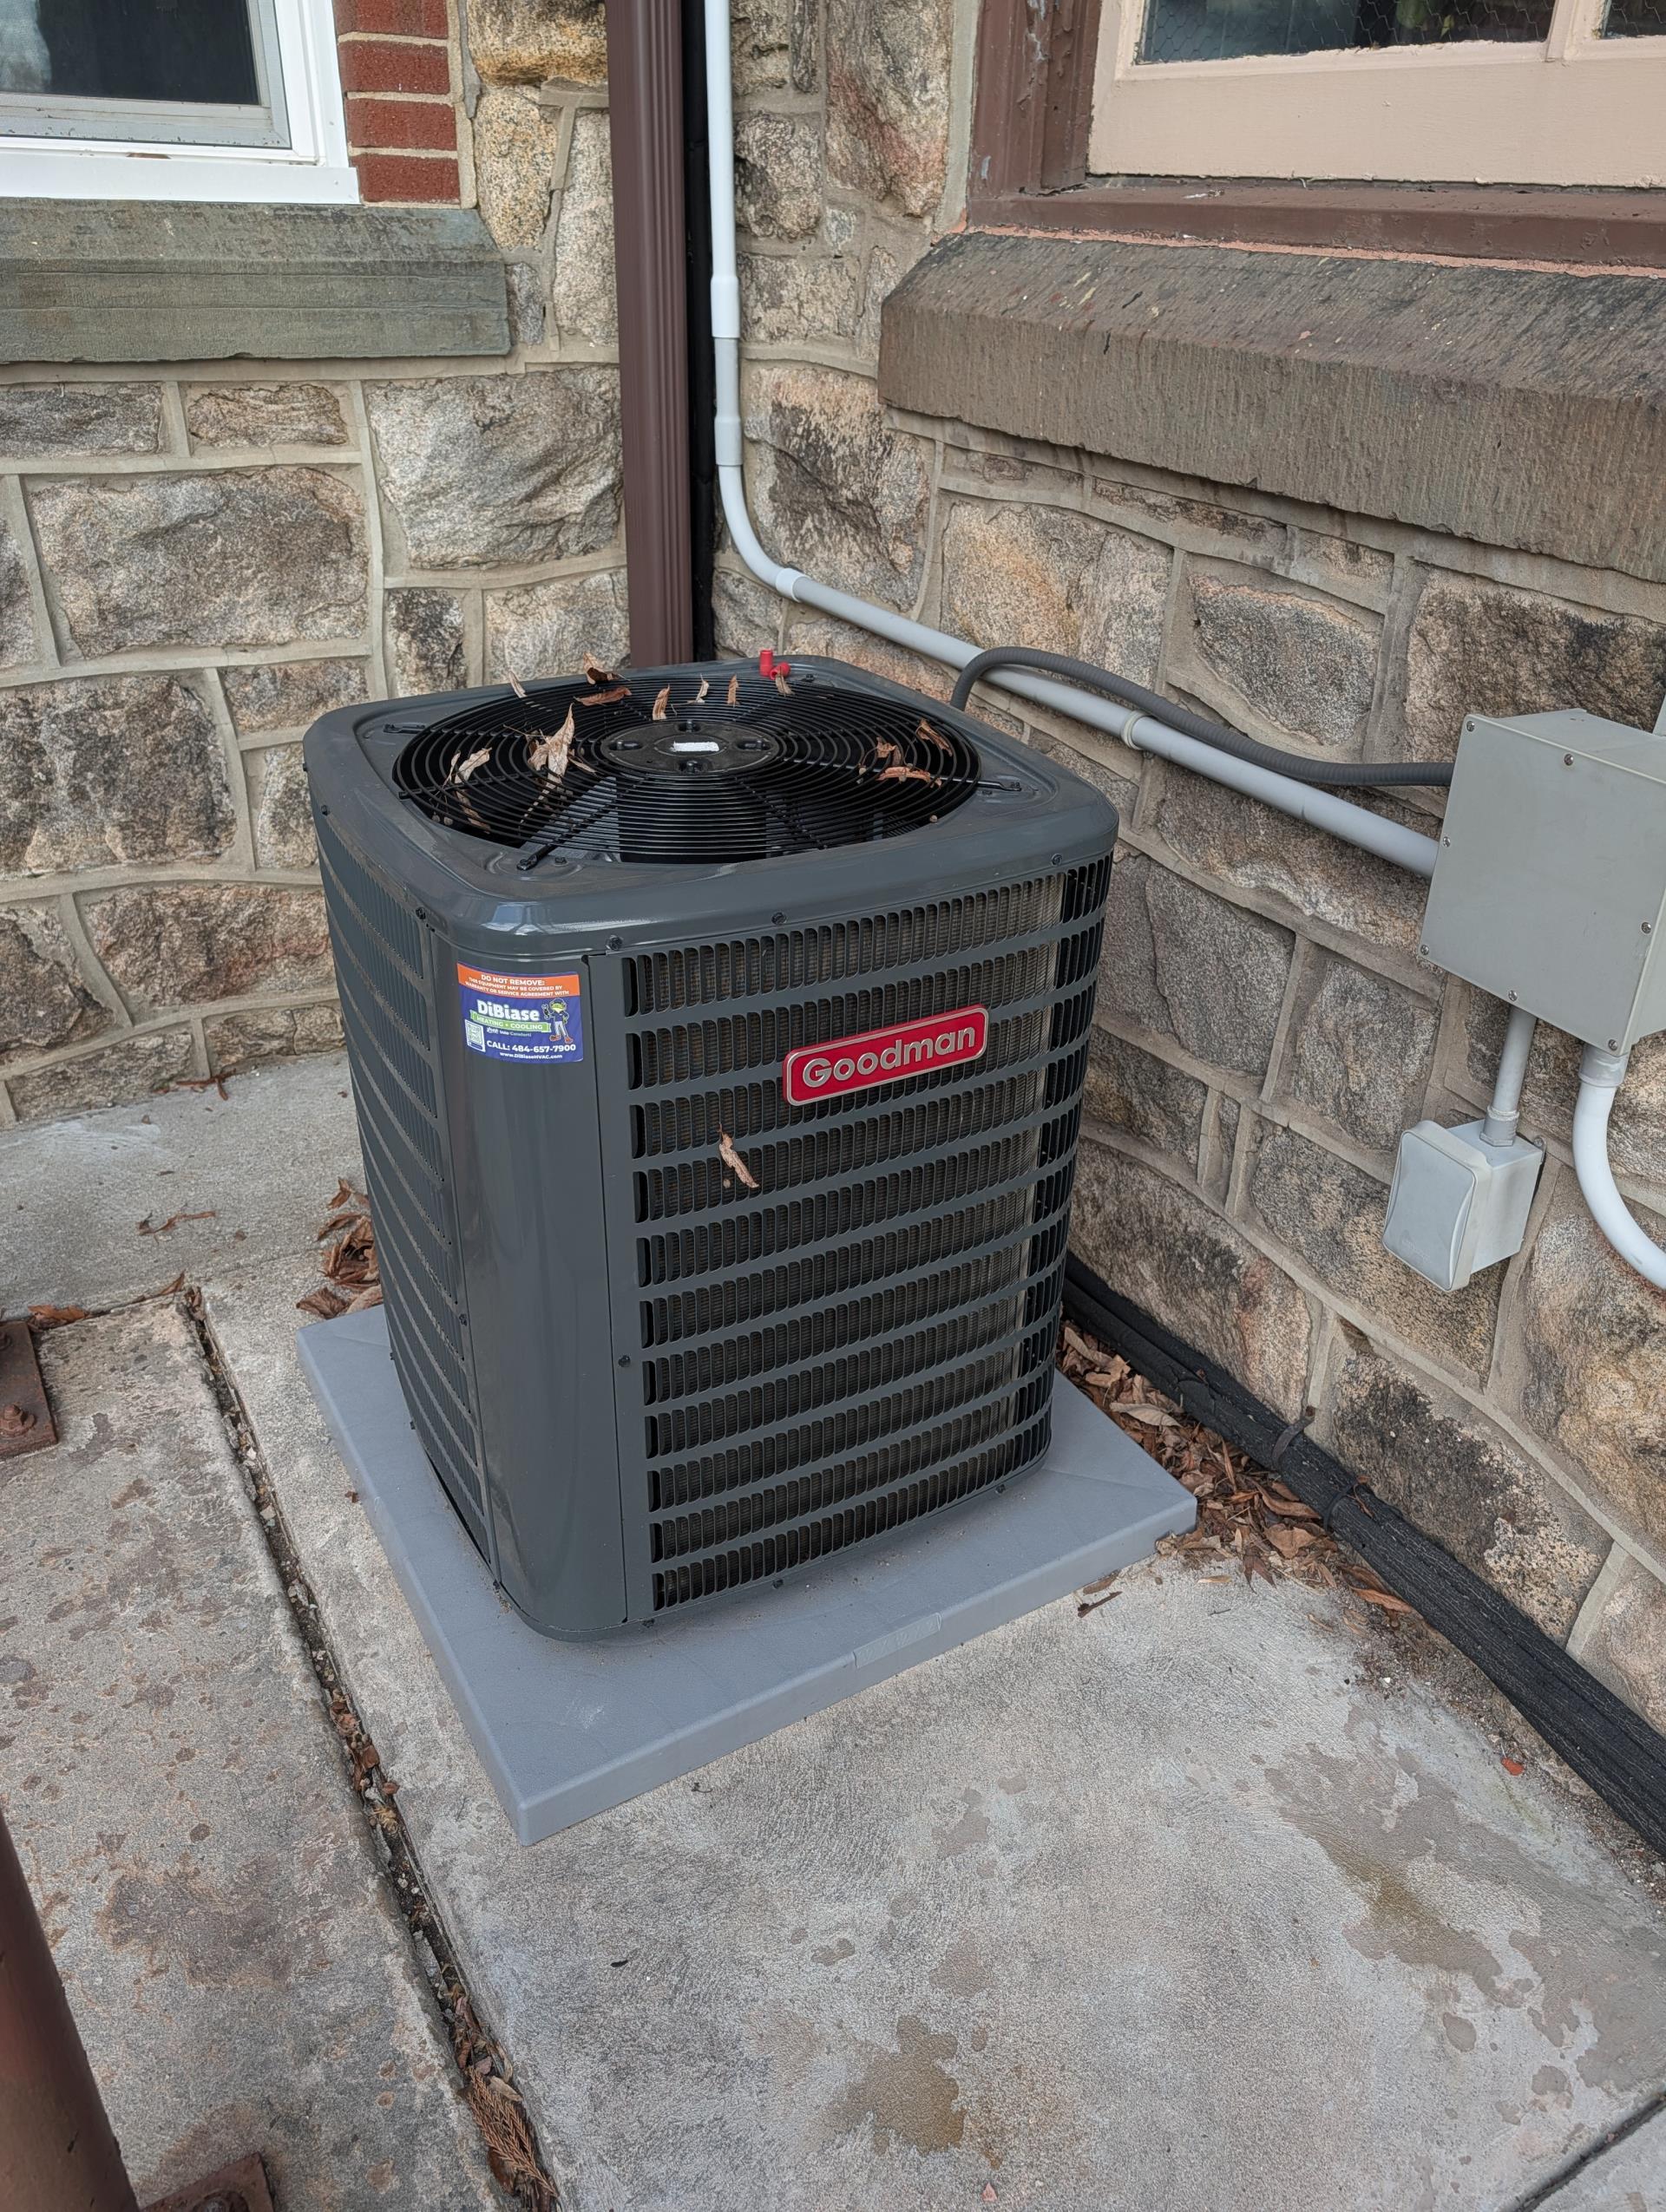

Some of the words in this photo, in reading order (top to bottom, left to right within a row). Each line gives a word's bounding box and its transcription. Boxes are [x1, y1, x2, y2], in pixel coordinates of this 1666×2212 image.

[478, 980, 506, 989] EQUIPMENT
[476, 999, 540, 1021] DiBiase
[476, 1016, 503, 1027] HEATING
[487, 1040, 510, 1050] CALL:
[803, 1026, 974, 1088] Goodman
